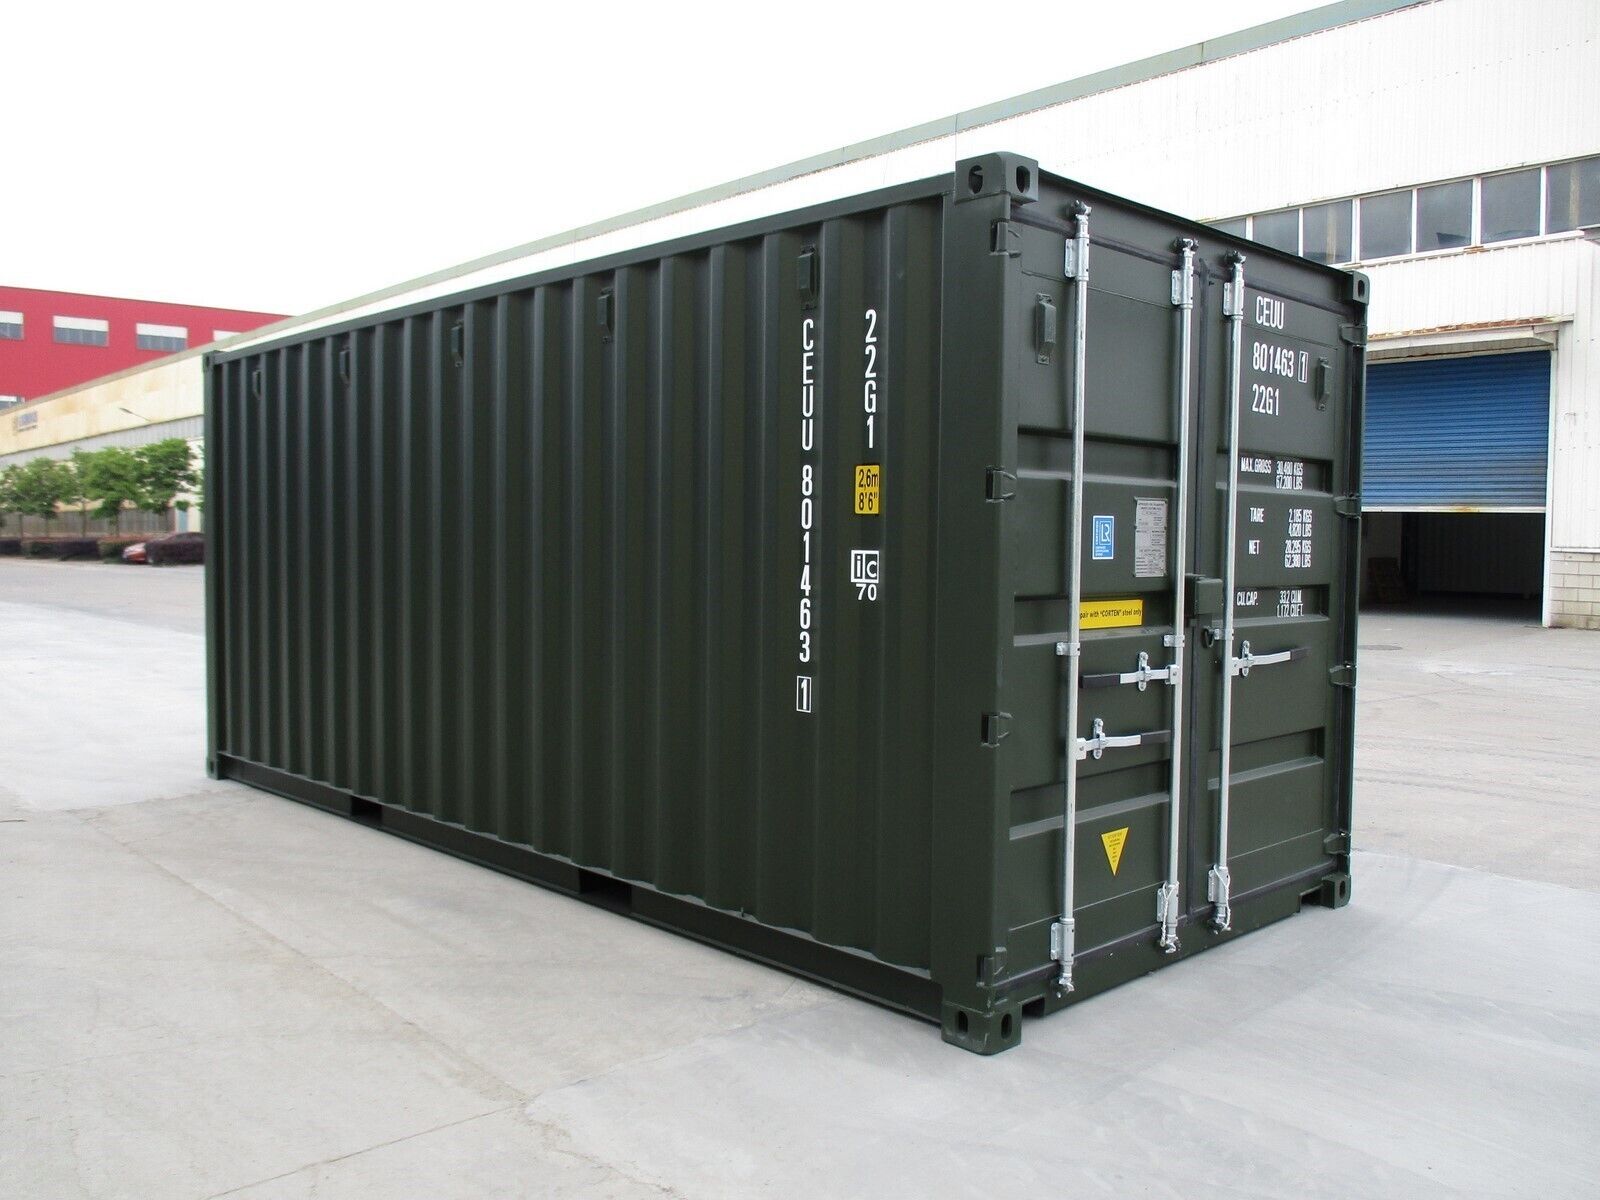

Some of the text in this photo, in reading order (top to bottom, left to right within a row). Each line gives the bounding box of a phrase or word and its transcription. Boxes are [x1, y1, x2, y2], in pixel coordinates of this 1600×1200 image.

[1255, 295, 1285, 330] CEUU
[1252, 341, 1295, 378] 801463
[801, 318, 814, 451] CEUU
[864, 308, 877, 449] 22G1
[1251, 383, 1280, 416] 22G1
[1293, 476, 1303, 490] LBS
[1249, 507, 1264, 523] TARE
[1302, 523, 1312, 537] LBS
[1248, 540, 1260, 555] NET
[799, 464, 813, 663] 801463
[1301, 554, 1311, 568] LBS
[855, 583, 877, 601] 70
